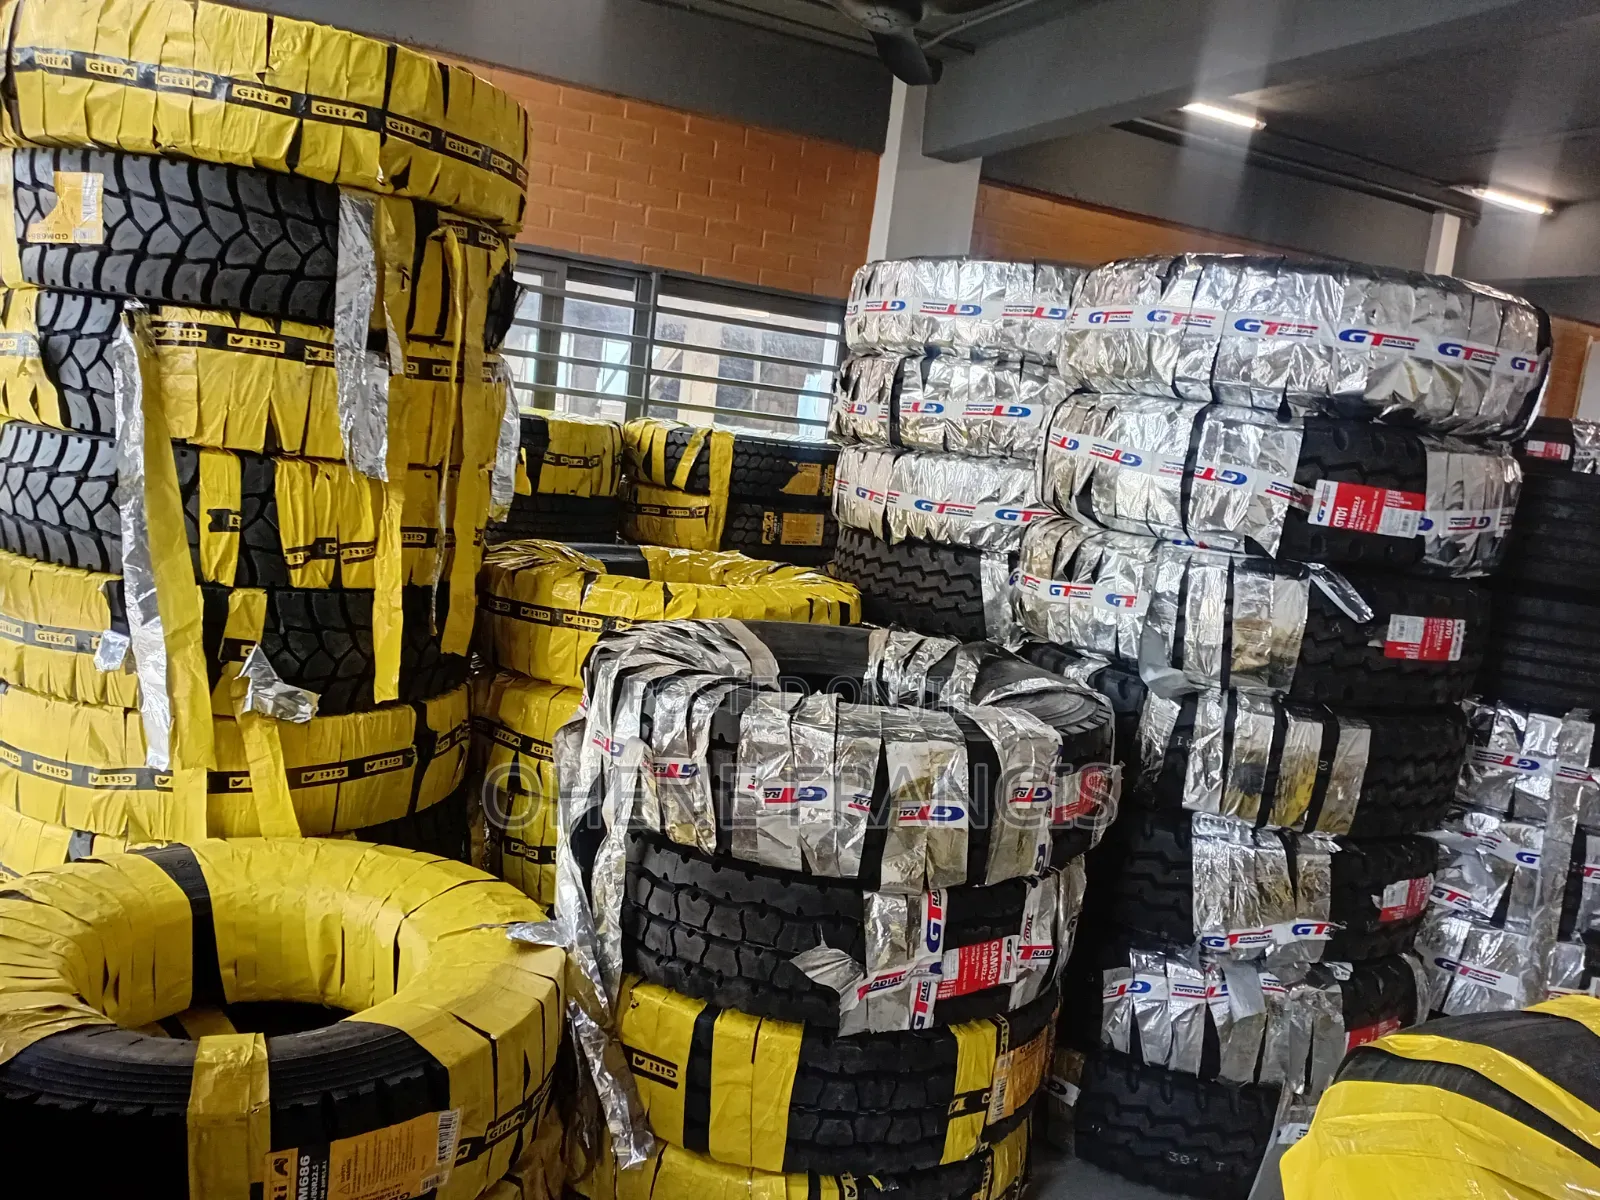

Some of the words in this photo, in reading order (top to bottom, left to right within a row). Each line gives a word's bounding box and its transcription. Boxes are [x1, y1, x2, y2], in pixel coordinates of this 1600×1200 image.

[88, 62, 118, 76] Giti
[158, 73, 191, 88] Giti
[236, 88, 270, 102] Giti
[315, 104, 348, 118] Giti
[389, 120, 416, 136] Giti
[448, 140, 470, 155] Giti
[882, 300, 906, 311] GT
[946, 304, 982, 316] GT
[1034, 306, 1068, 320] GT
[1088, 311, 1111, 324] GT
[1147, 310, 1185, 325] GT
[1234, 318, 1280, 336] GT
[248, 338, 282, 351] Giti
[1338, 330, 1383, 346] GT
[1438, 342, 1472, 360] GT
[1510, 356, 1537, 372] GT
[912, 402, 945, 415] GT
[994, 405, 1032, 418] GT
[1060, 436, 1080, 450] GT
[1114, 450, 1142, 467] GT
[1202, 467, 1248, 486] GT
[856, 487, 876, 500] GT
[914, 500, 946, 514] GT
[994, 508, 1034, 522] GT
[1332, 507, 1348, 528] GT01
[1472, 516, 1491, 530] GT
[402, 532, 424, 541] Giti
[1050, 584, 1071, 597] GT
[1104, 593, 1137, 608] GT
[530, 609, 550, 621] Giti
[577, 616, 600, 628] Giti
[38, 632, 60, 644] Giti
[380, 756, 401, 766] Giti
[1503, 755, 1540, 770] GT
[46, 764, 69, 778] Giti
[320, 769, 345, 778] Giti
[667, 763, 700, 778] GT
[106, 774, 133, 784] Giti
[781, 786, 828, 804] GT
[1023, 786, 1052, 803] GT
[917, 804, 964, 822] GT
[1431, 886, 1458, 902] GT
[927, 907, 942, 953] GT
[1292, 924, 1326, 935] GT
[1202, 934, 1239, 948] GT
[986, 941, 1000, 987] GAM831
[1434, 958, 1470, 976] GT
[1116, 980, 1152, 996] GT
[912, 1002, 928, 1030] GT
[920, 980, 928, 1002] RAD
[649, 1061, 678, 1079] Giti
[488, 1119, 512, 1140] Giti
[300, 1156, 310, 1200] M686
